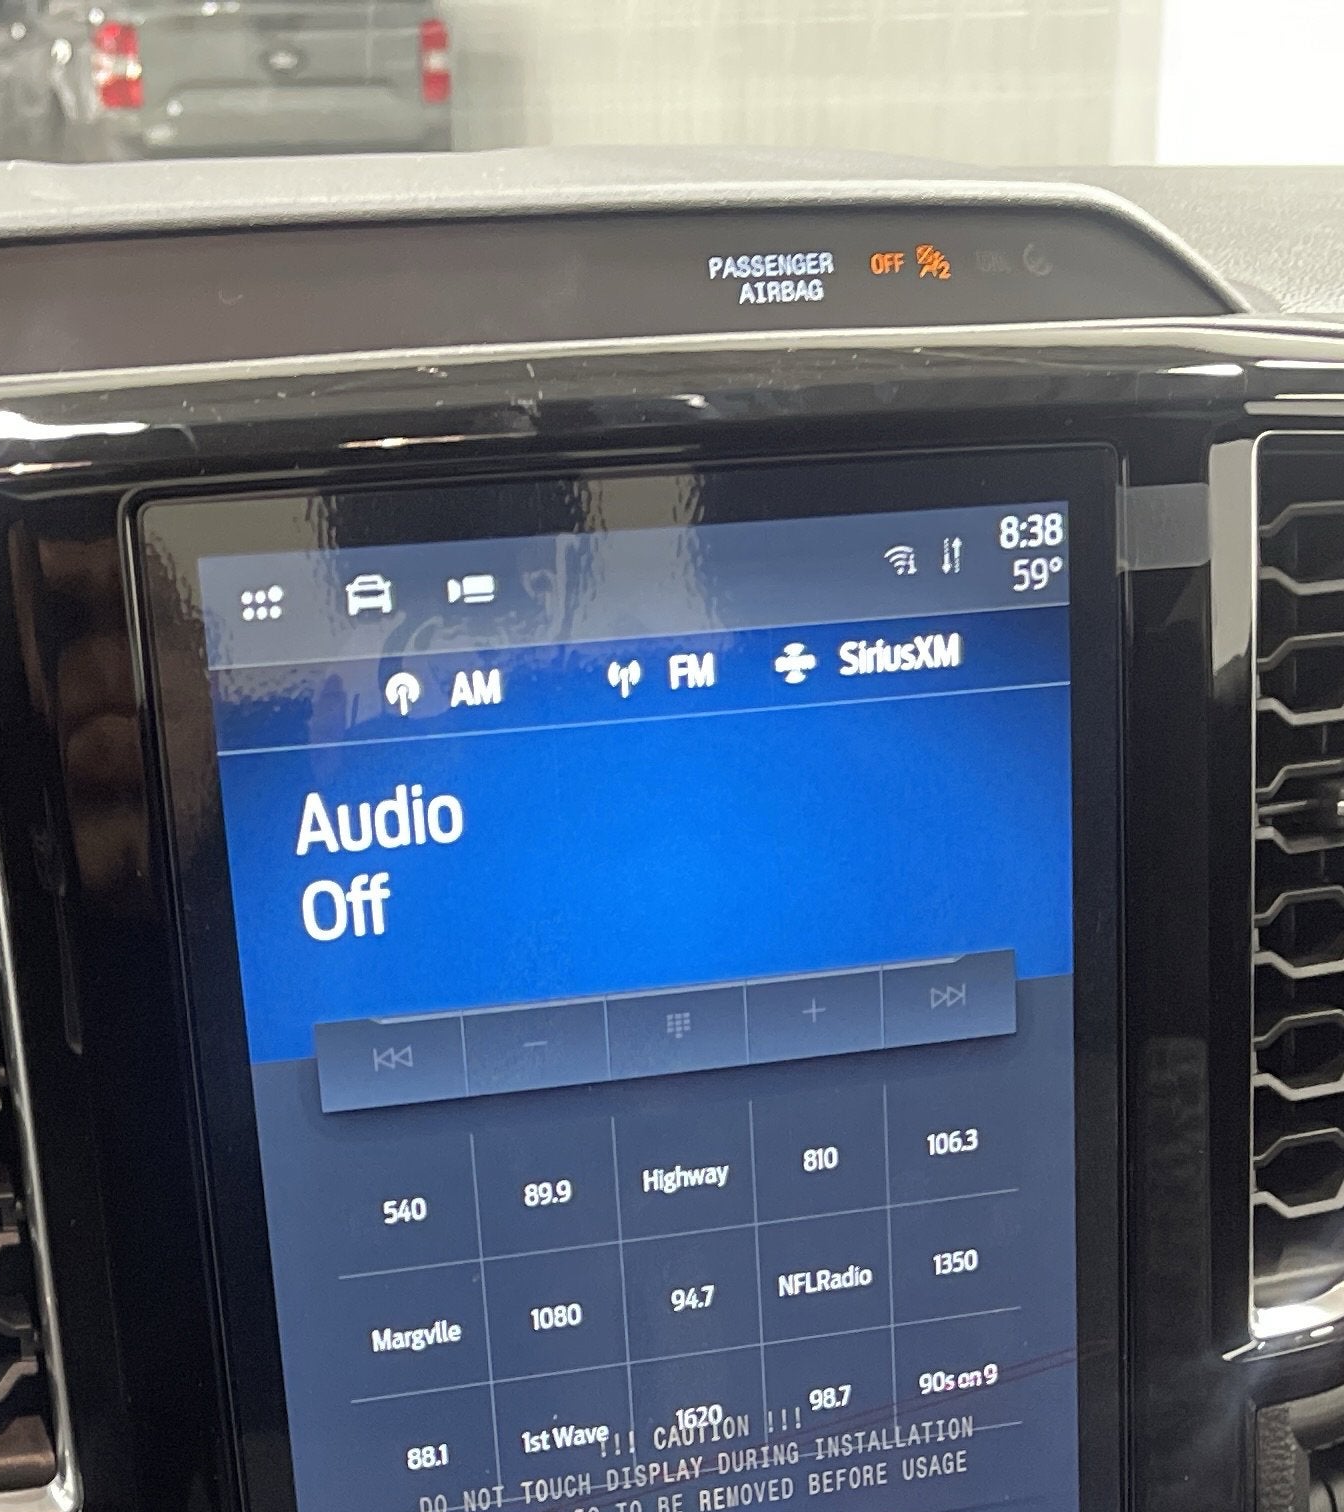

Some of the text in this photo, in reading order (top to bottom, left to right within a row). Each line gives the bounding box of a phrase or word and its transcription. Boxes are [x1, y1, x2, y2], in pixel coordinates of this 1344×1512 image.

[708, 252, 834, 280] PASSENGER
[870, 253, 904, 275] OFF
[739, 279, 824, 304] AIRBAG
[999, 513, 1064, 549] 8:38
[1013, 556, 1063, 592] 59°
[839, 632, 961, 676] SiriusXM
[669, 652, 716, 690] FM
[451, 669, 502, 707] AM
[296, 784, 464, 856] Audio
[302, 872, 391, 941] Off
[927, 1128, 978, 1156] 106.3
[803, 1146, 839, 1172] 810
[523, 1179, 573, 1207] 89.9
[642, 1164, 730, 1194] Highway
[383, 1197, 427, 1225] 540
[933, 1249, 979, 1276] 1350
[670, 1284, 716, 1312] 94.7
[530, 1303, 583, 1331] 1080
[371, 1319, 462, 1352] Margvlle
[919, 1363, 999, 1395] 90s on 9
[809, 1384, 852, 1411] 98.7
[675, 1404, 724, 1431] 1620
[522, 1425, 610, 1454] 1st Wave
[653, 1414, 750, 1451] CAUTION
[407, 1443, 450, 1471] 88.1
[463, 1485, 505, 1512] NOT
[520, 1472, 592, 1505] TOUCH
[606, 1456, 704, 1493] DISPLAY
[717, 1442, 800, 1477] DURING
[815, 1415, 975, 1461] INSTALLATION
[699, 1477, 794, 1512] REMOVED
[808, 1461, 888, 1496] BEFORE
[901, 1450, 968, 1481] USAGE
